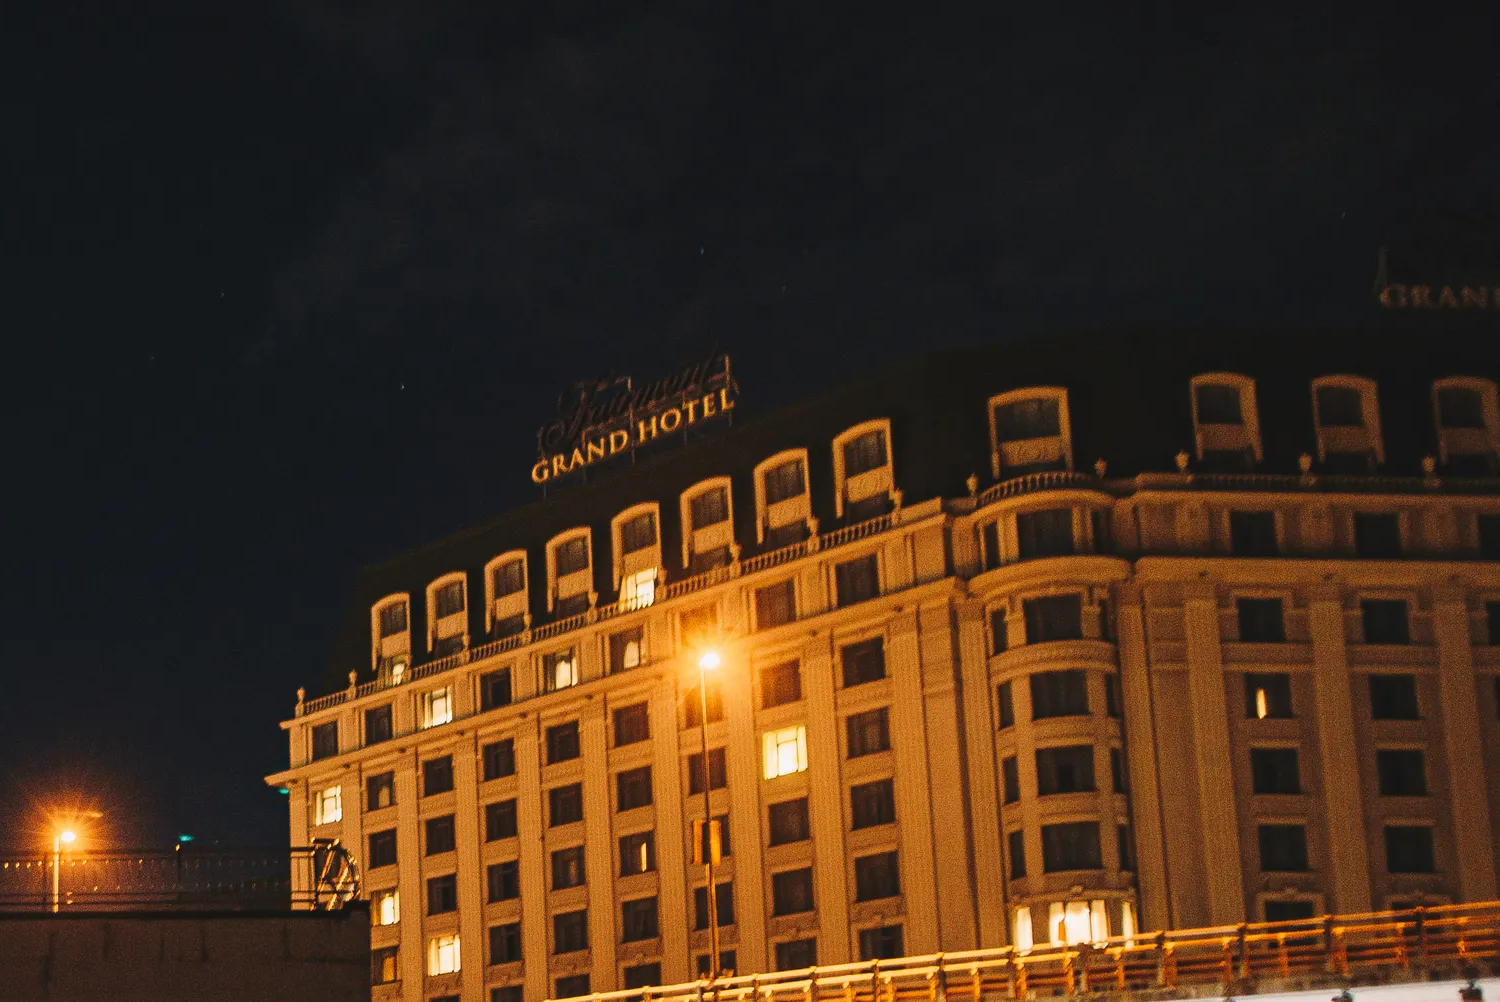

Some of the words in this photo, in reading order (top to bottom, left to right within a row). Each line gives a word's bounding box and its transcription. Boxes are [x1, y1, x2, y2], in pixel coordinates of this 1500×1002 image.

[1379, 282, 1500, 309] GRAN
[531, 429, 629, 484] GRAND
[638, 387, 735, 443] HOTEL
